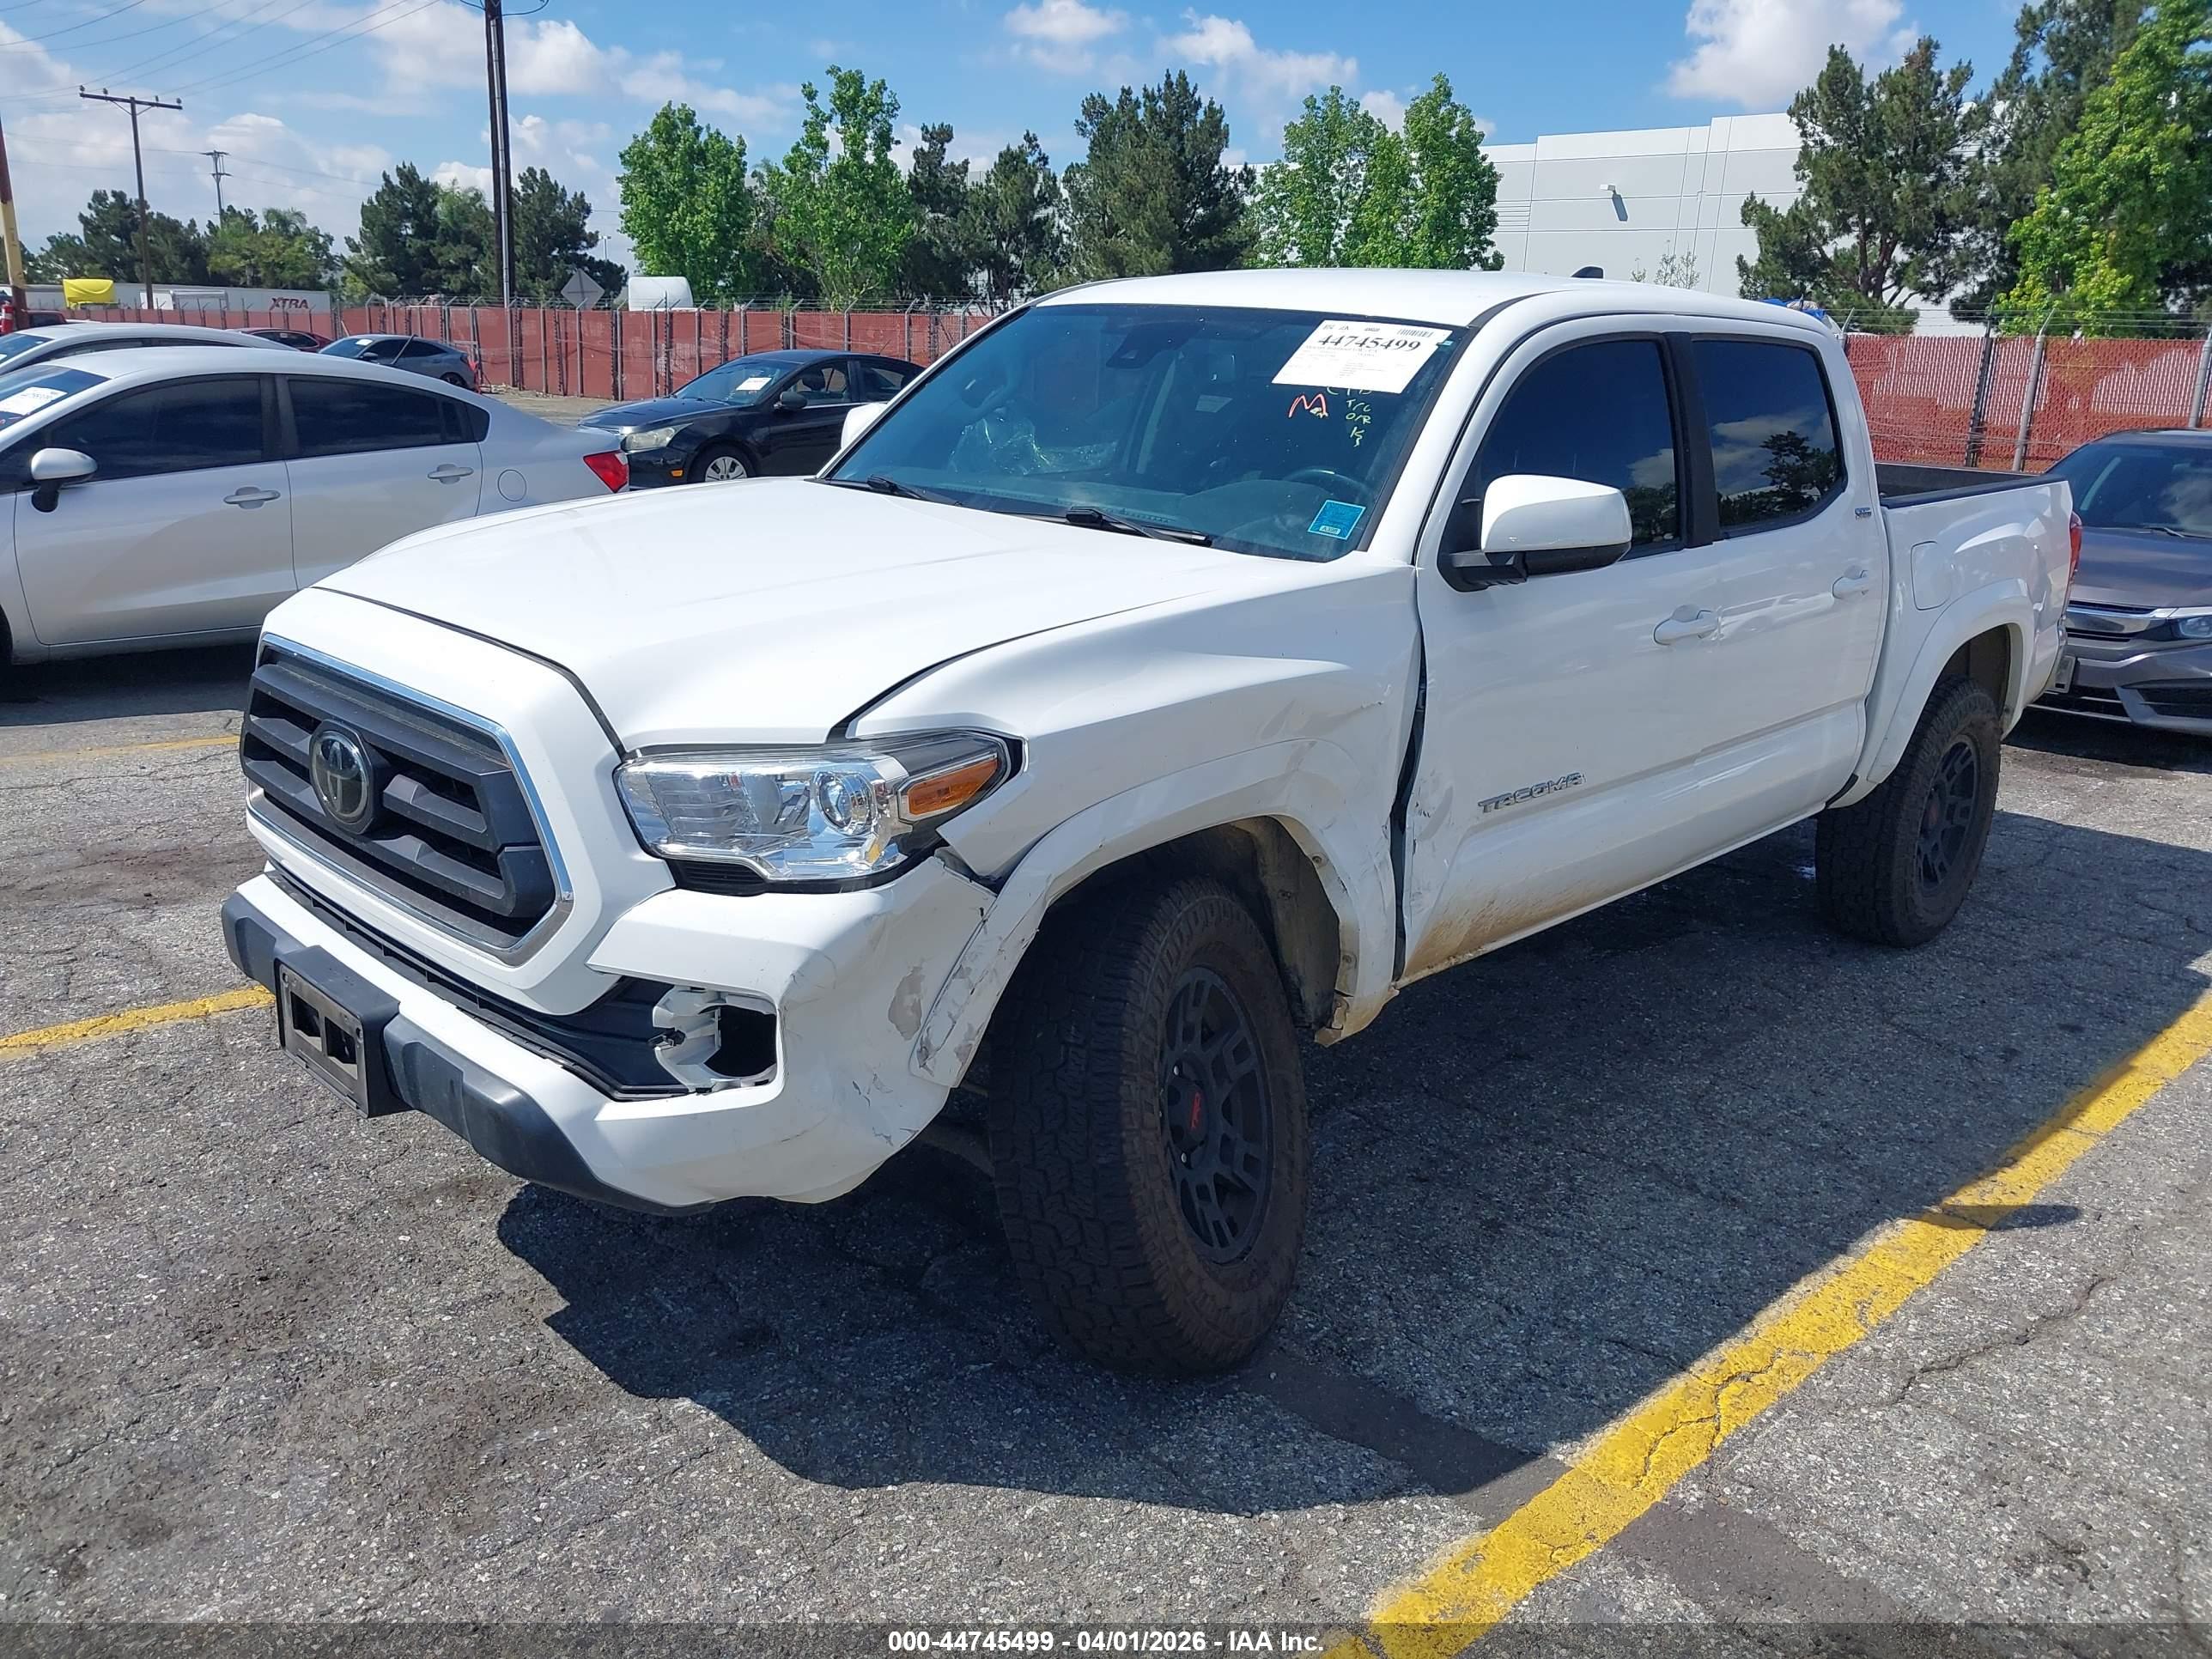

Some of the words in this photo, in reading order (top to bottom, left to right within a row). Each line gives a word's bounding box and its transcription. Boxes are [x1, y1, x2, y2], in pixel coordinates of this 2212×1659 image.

[270, 297, 309, 309] XTRA
[1317, 334, 1421, 352] 44745499
[1477, 772, 1587, 813] TACOMA
